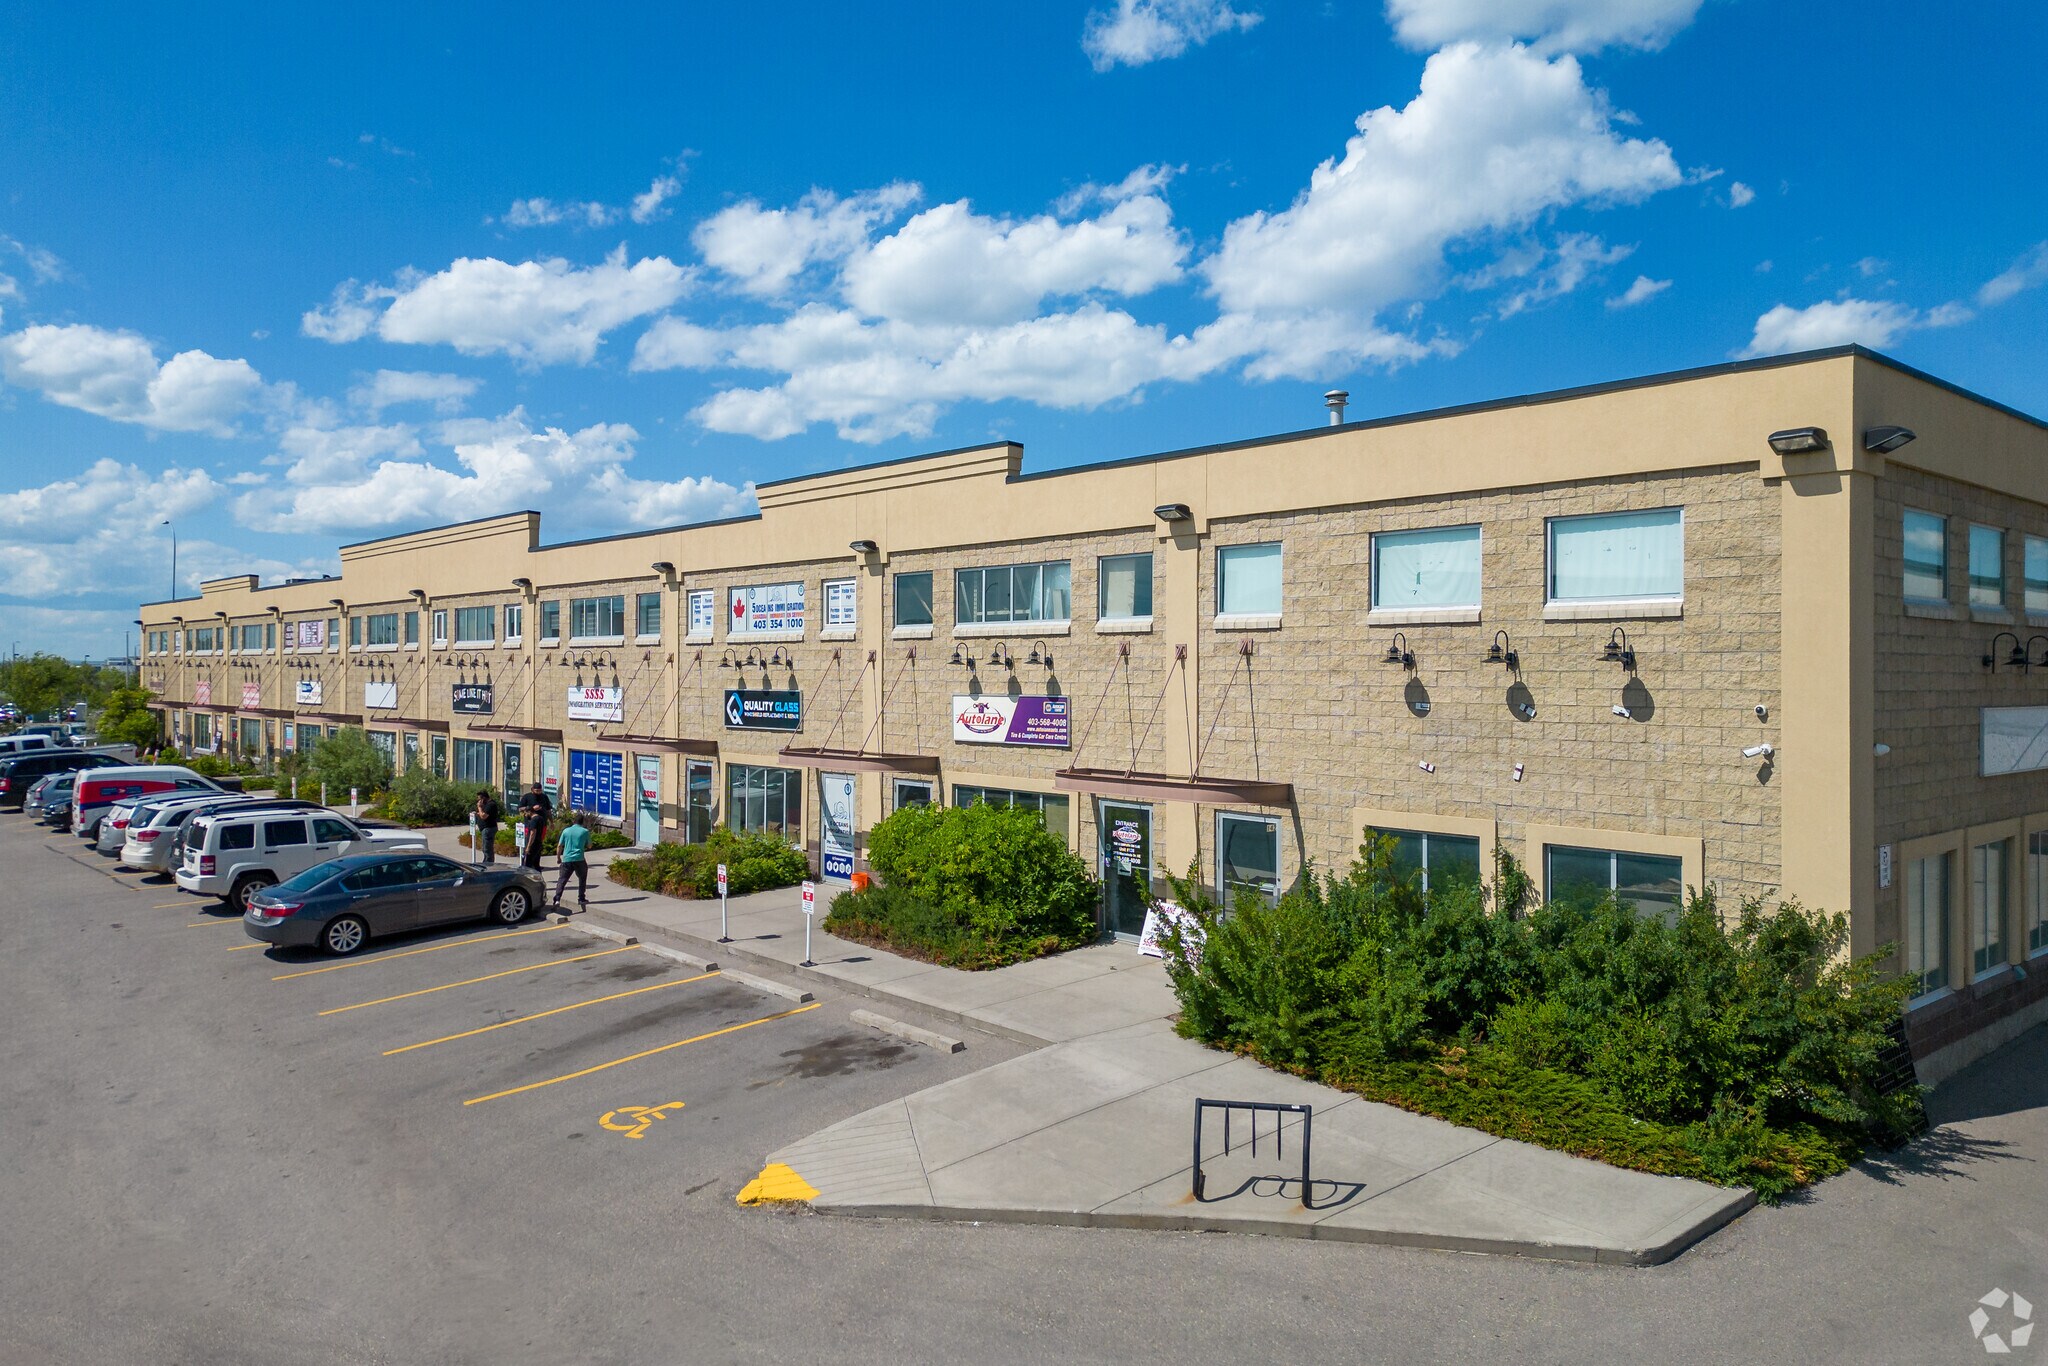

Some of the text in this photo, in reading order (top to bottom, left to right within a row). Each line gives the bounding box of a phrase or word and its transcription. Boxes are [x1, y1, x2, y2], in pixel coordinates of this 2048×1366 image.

[753, 618, 803, 629] 403 354 1010
[584, 688, 604, 700] SSSS
[744, 700, 798, 712] QUALITY GLASS
[956, 713, 1005, 726] Autolane
[1115, 820, 1139, 828] ENTRANCE
